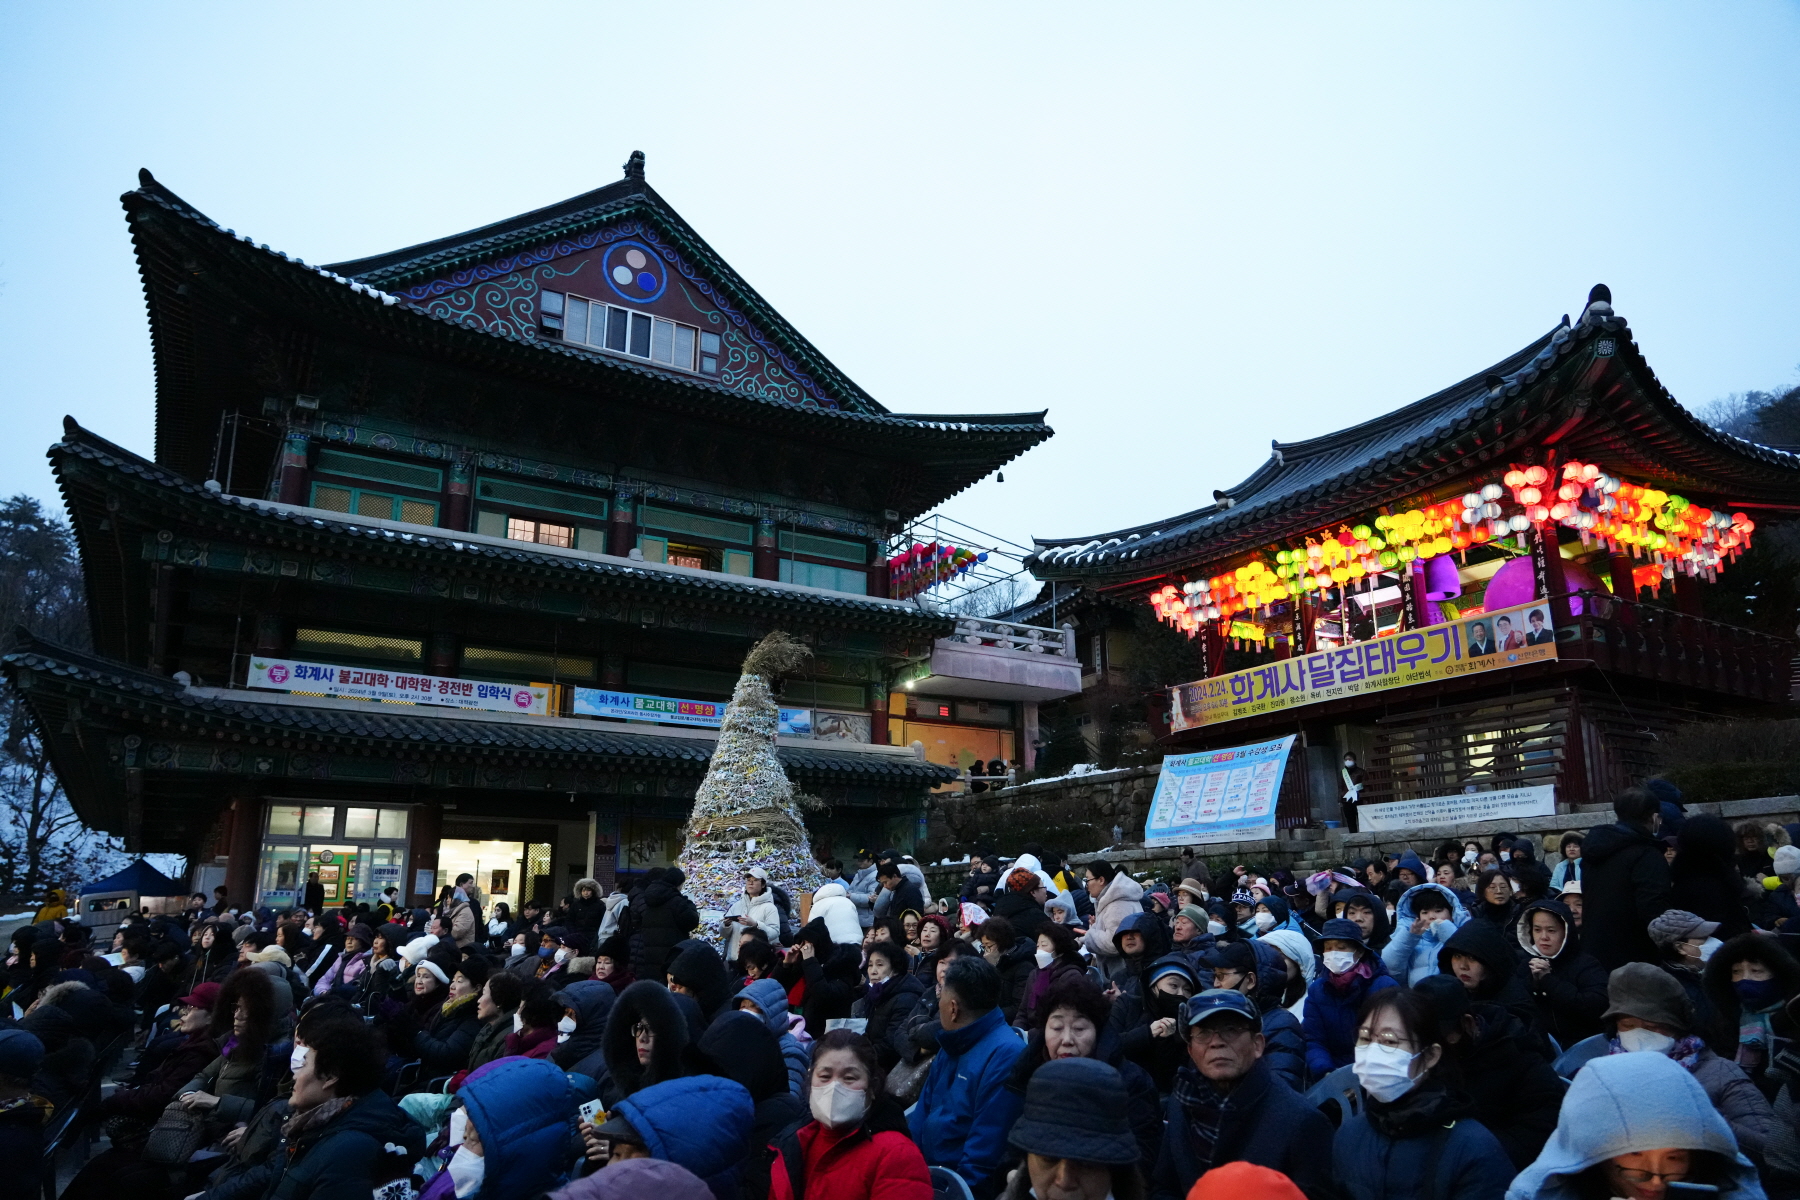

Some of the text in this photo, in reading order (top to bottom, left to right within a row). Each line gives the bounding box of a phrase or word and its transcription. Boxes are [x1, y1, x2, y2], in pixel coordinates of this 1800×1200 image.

[1517, 649, 1546, 660] 신한은행
[1468, 658, 1495, 671] 화계사
[293, 664, 335, 683] 화계사
[477, 684, 512, 701] 입학식
[1365, 676, 1400, 689] 화계사합창단
[1189, 680, 1229, 703] 2024.2.24.
[598, 694, 630, 707] 화계사
[634, 697, 677, 712] 불교대학
